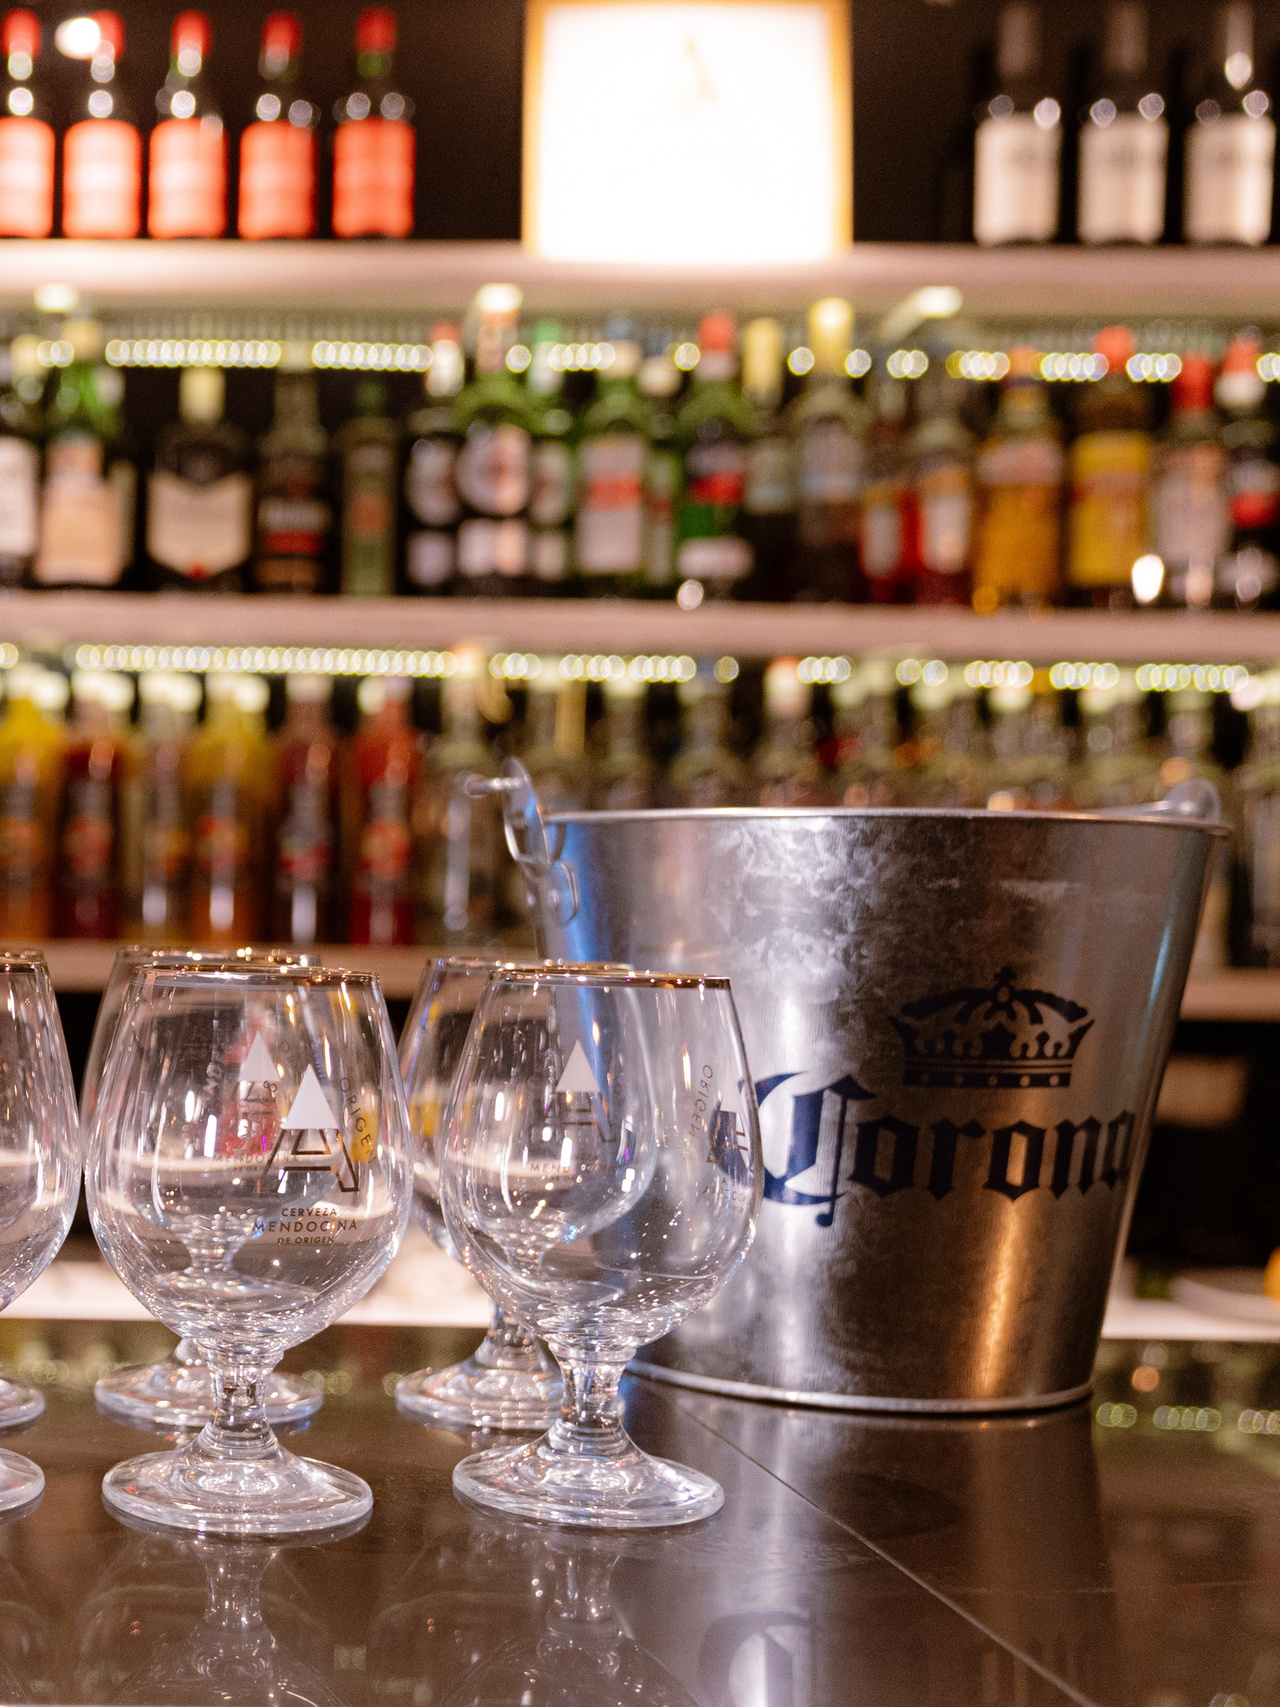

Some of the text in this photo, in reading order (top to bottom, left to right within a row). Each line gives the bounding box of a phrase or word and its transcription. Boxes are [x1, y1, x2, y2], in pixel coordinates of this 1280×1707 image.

[742, 1071, 1135, 1227] Corona
[281, 1207, 337, 1217] CERVEZA
[252, 1219, 357, 1233] MENDOCNA
[277, 1235, 334, 1245] DE ORIGEN
